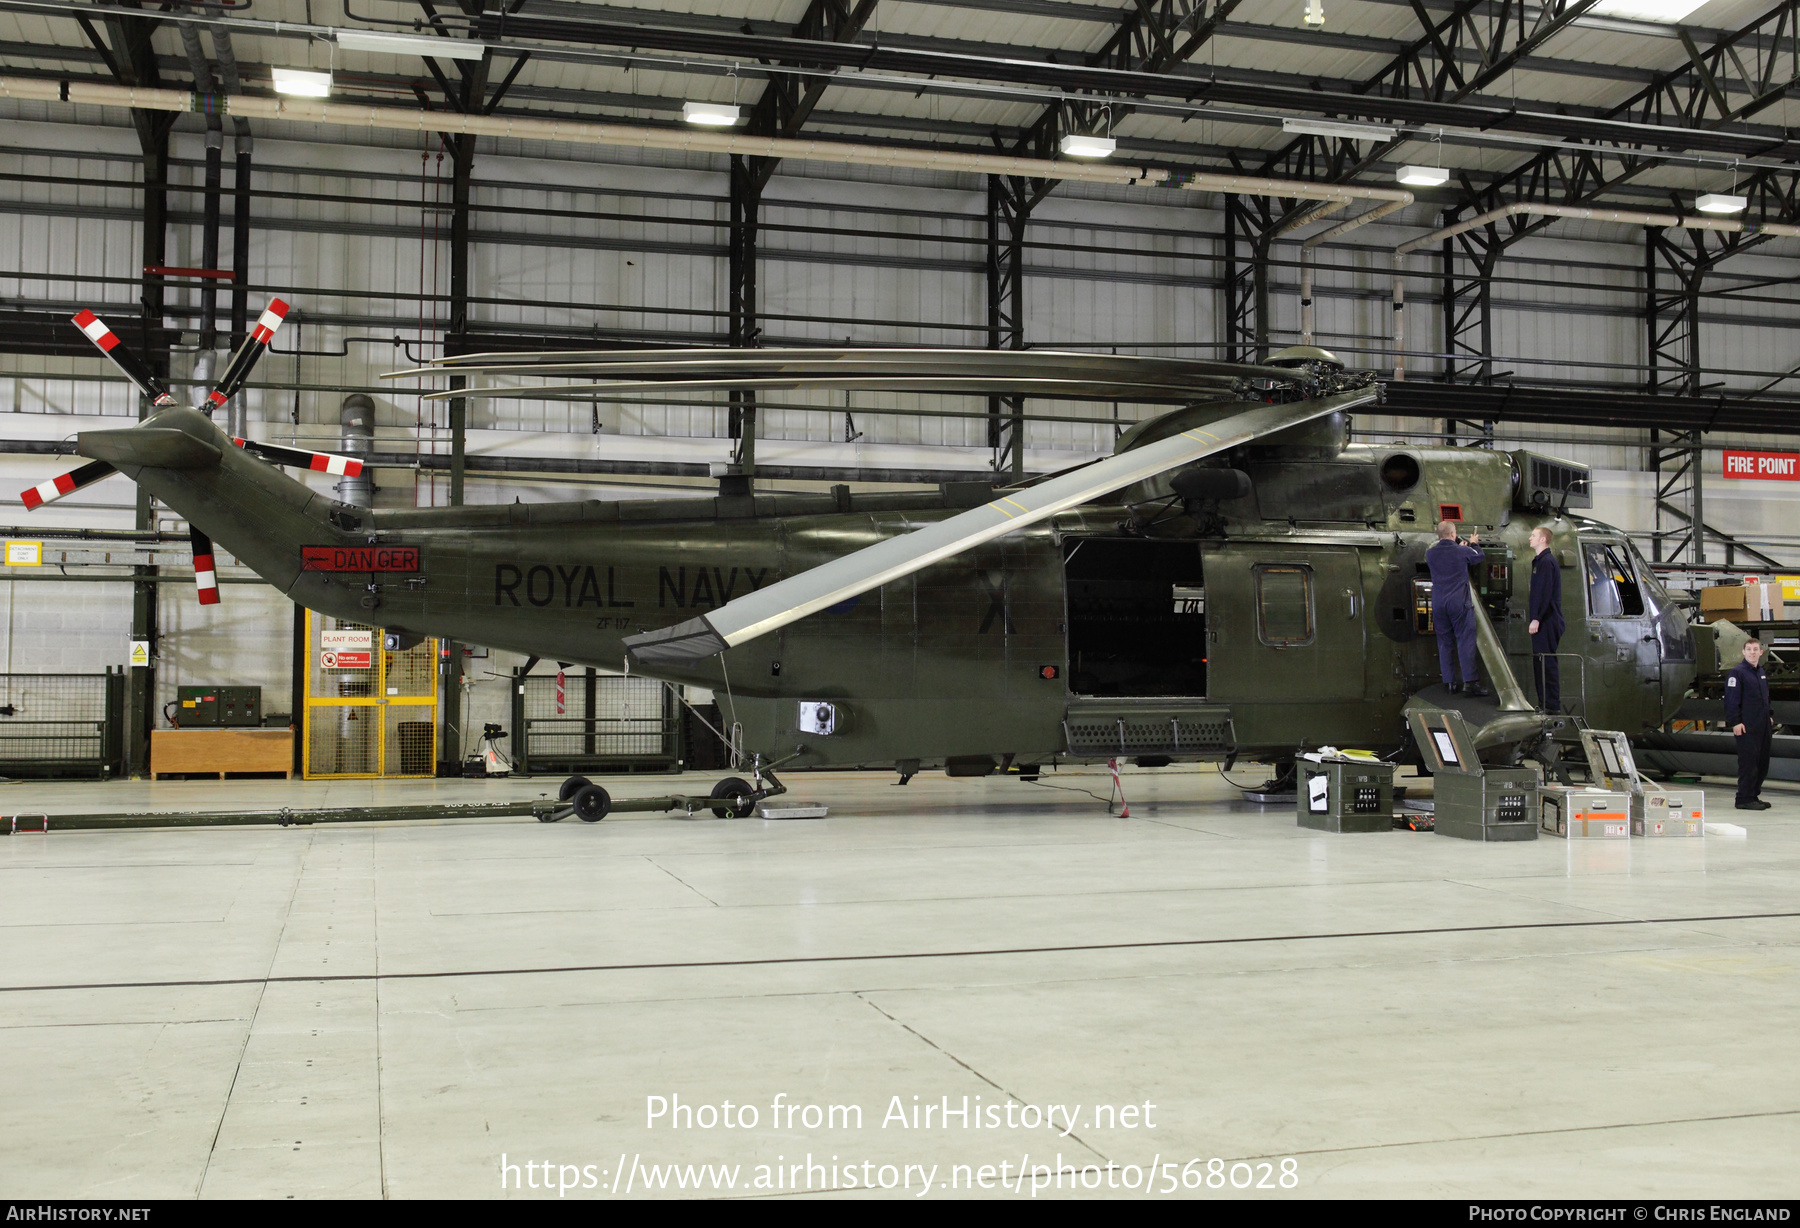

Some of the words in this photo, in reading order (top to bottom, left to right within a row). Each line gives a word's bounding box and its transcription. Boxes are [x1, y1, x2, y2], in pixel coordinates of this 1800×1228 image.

[1728, 456, 1754, 473] FIRE
[1758, 457, 1796, 475] POINT
[334, 550, 415, 569] DANGER
[495, 564, 635, 608] ROYAL
[658, 565, 768, 608] NAVY
